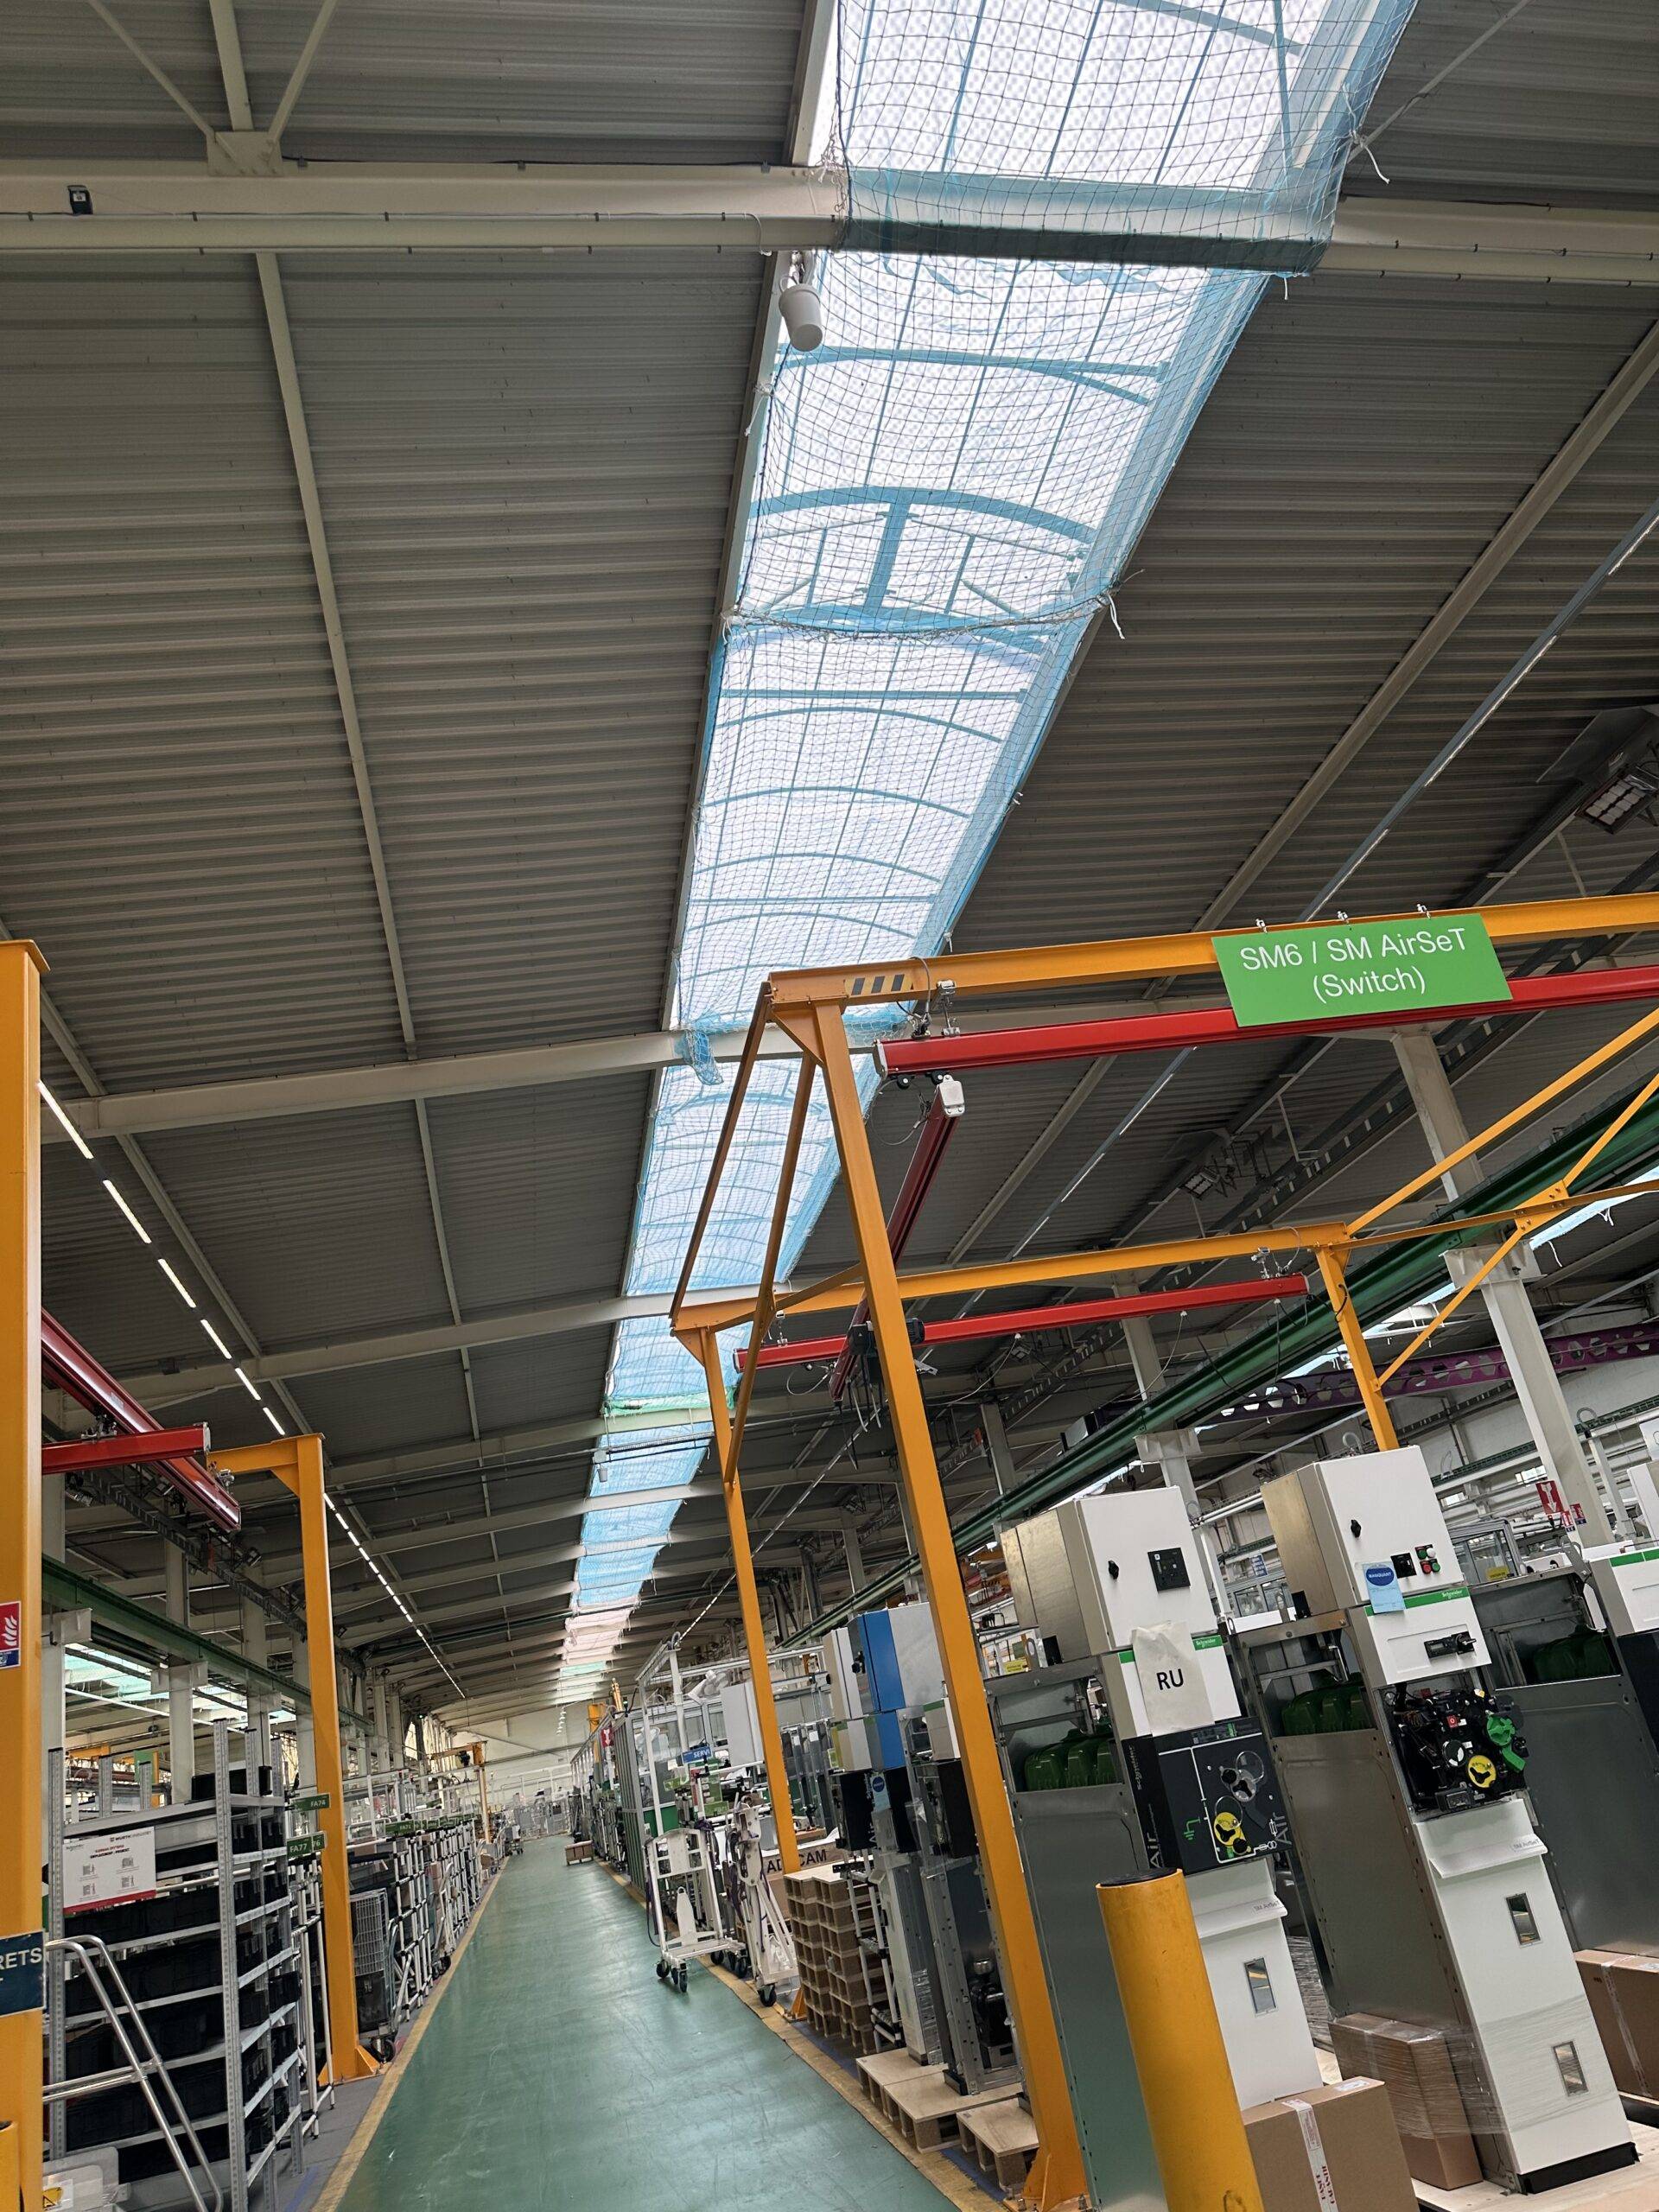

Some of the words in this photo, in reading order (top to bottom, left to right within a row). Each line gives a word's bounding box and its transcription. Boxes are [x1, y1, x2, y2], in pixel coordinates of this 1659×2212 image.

[1240, 943, 1303, 970] SM6
[1312, 940, 1318, 964] /
[1326, 937, 1372, 962] SM
[1382, 927, 1465, 957] AirSeT
[1313, 965, 1426, 1004] (Switch)
[1156, 1668, 1184, 1691] RU
[1272, 1812, 1293, 1846] Air
[289, 1843, 308, 1853] FA77
[1147, 1832, 1160, 1868] Air
